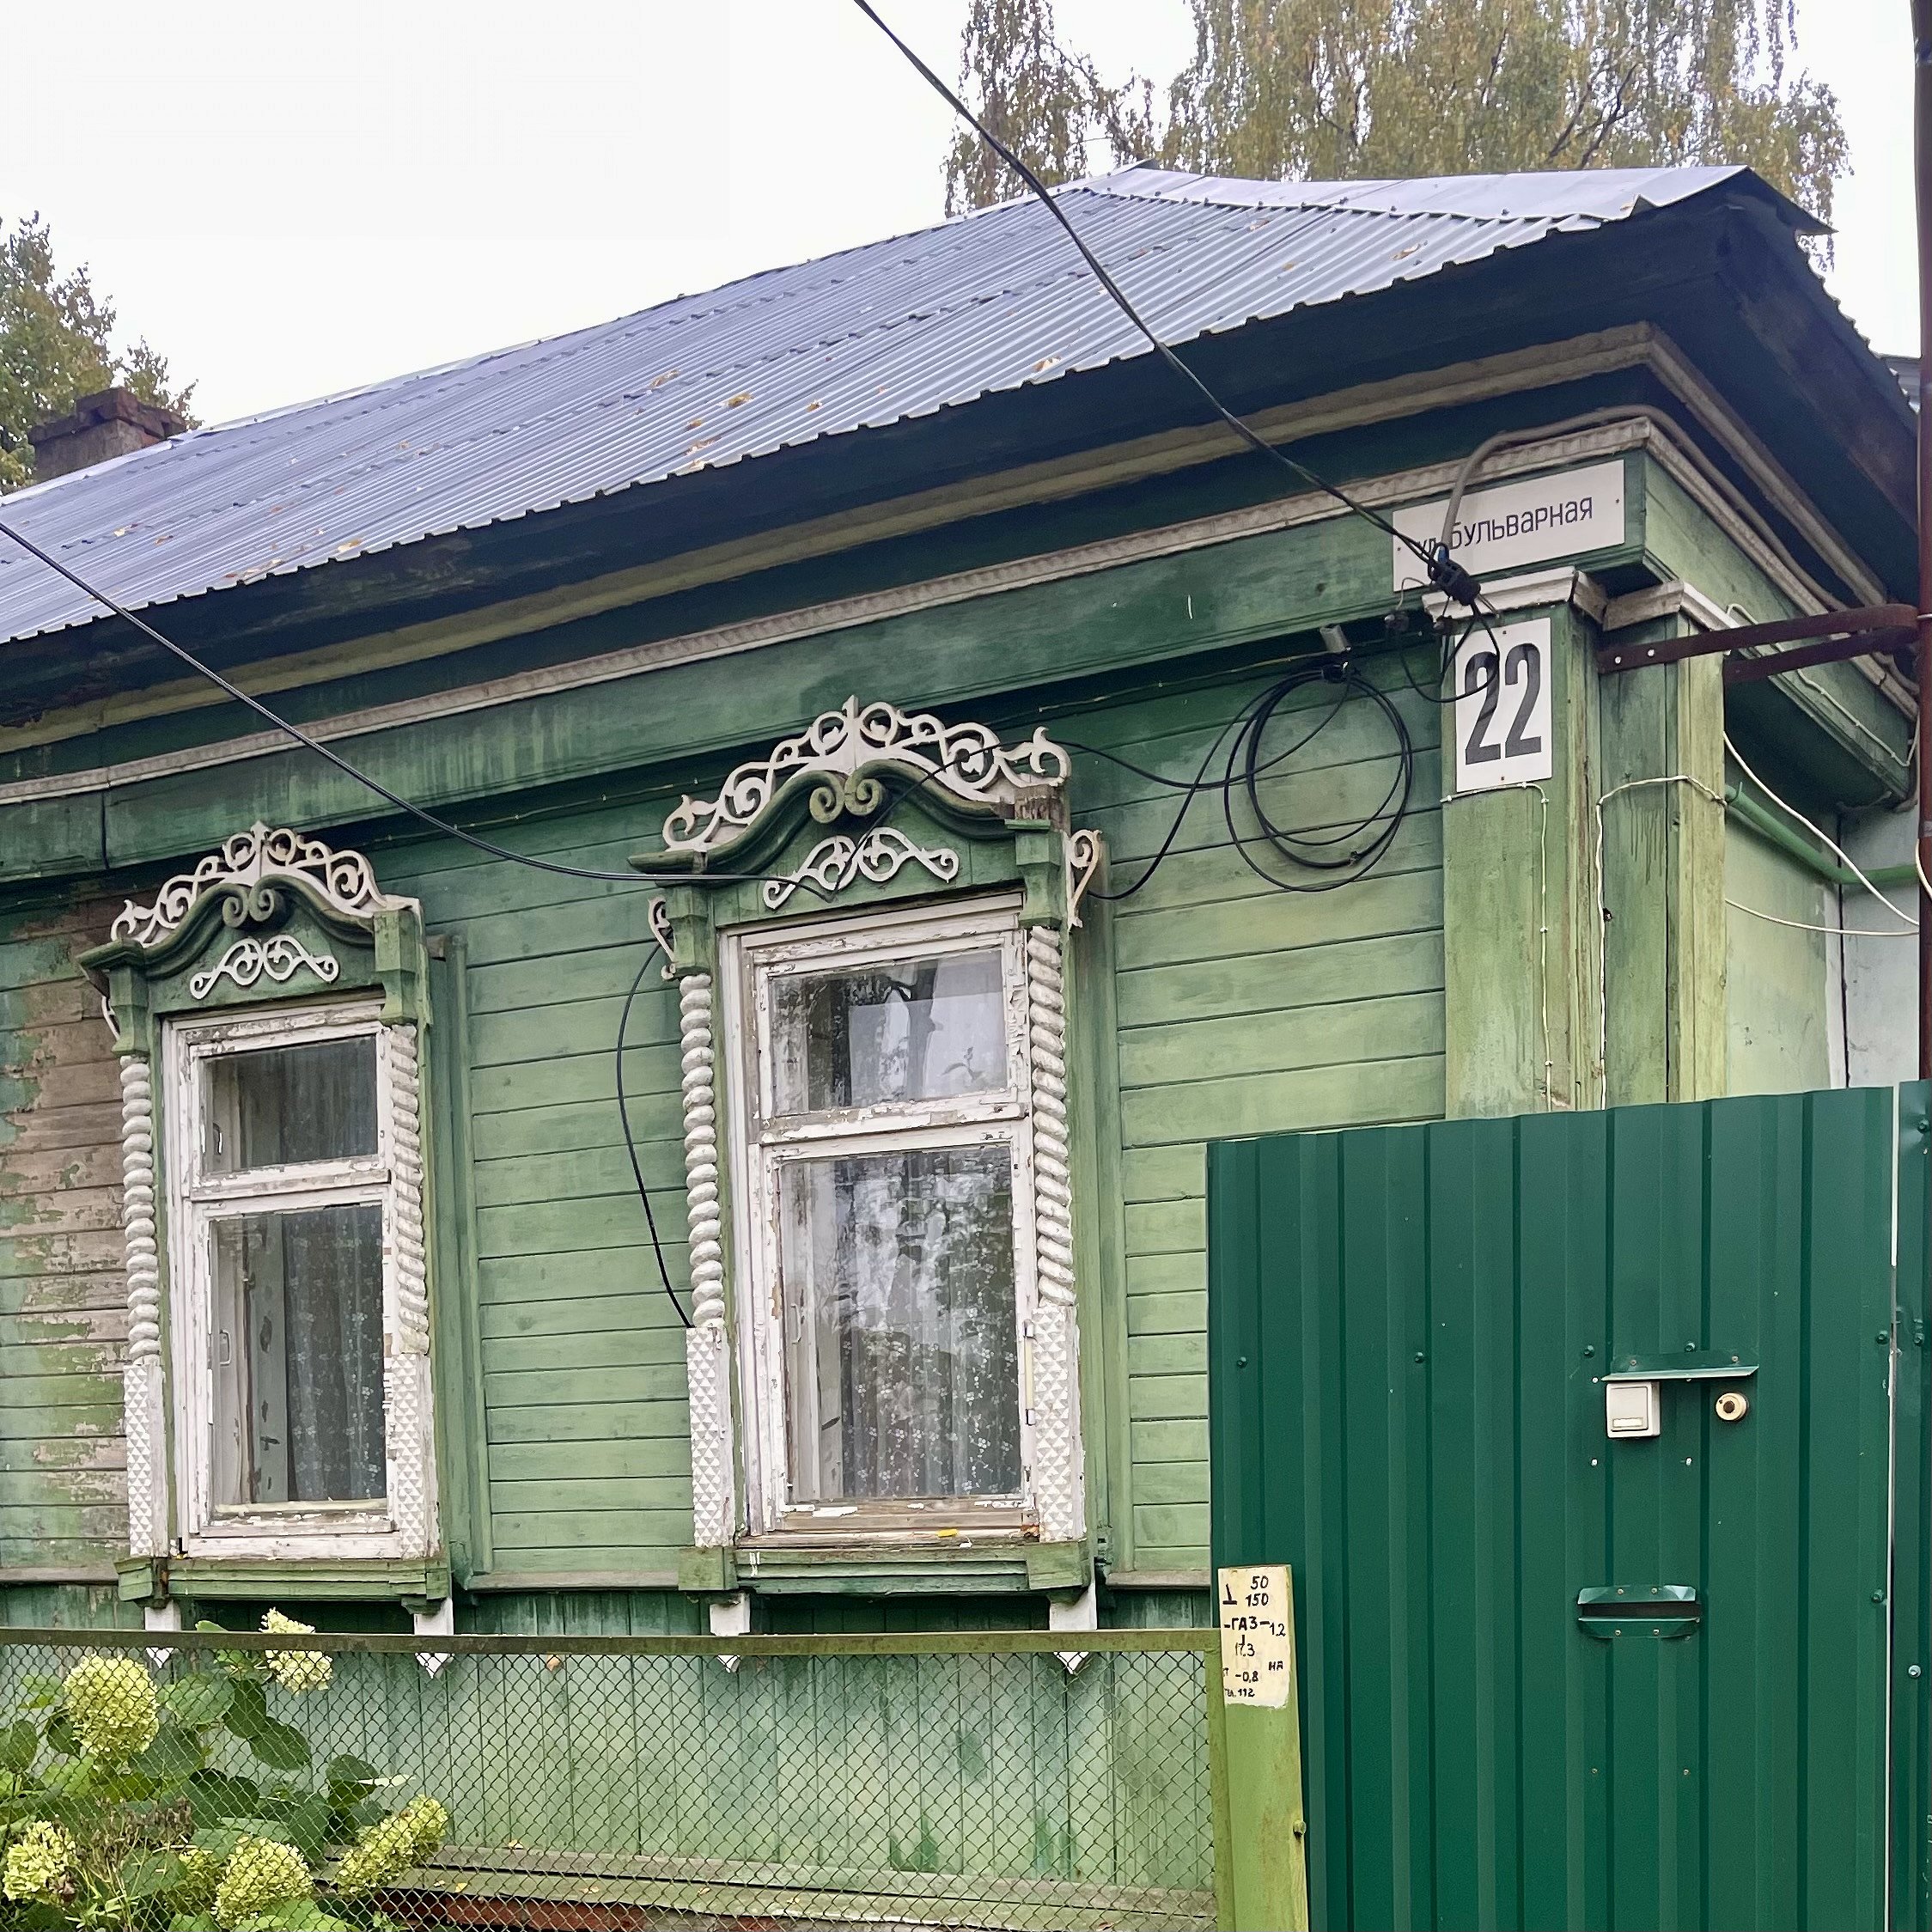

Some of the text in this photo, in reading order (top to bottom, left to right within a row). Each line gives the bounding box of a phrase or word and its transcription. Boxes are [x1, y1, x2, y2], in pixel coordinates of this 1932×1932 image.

[1464, 643, 1542, 765] 22
[1250, 1575, 1269, 1590] 50
[1245, 1593, 1269, 1606] 150
